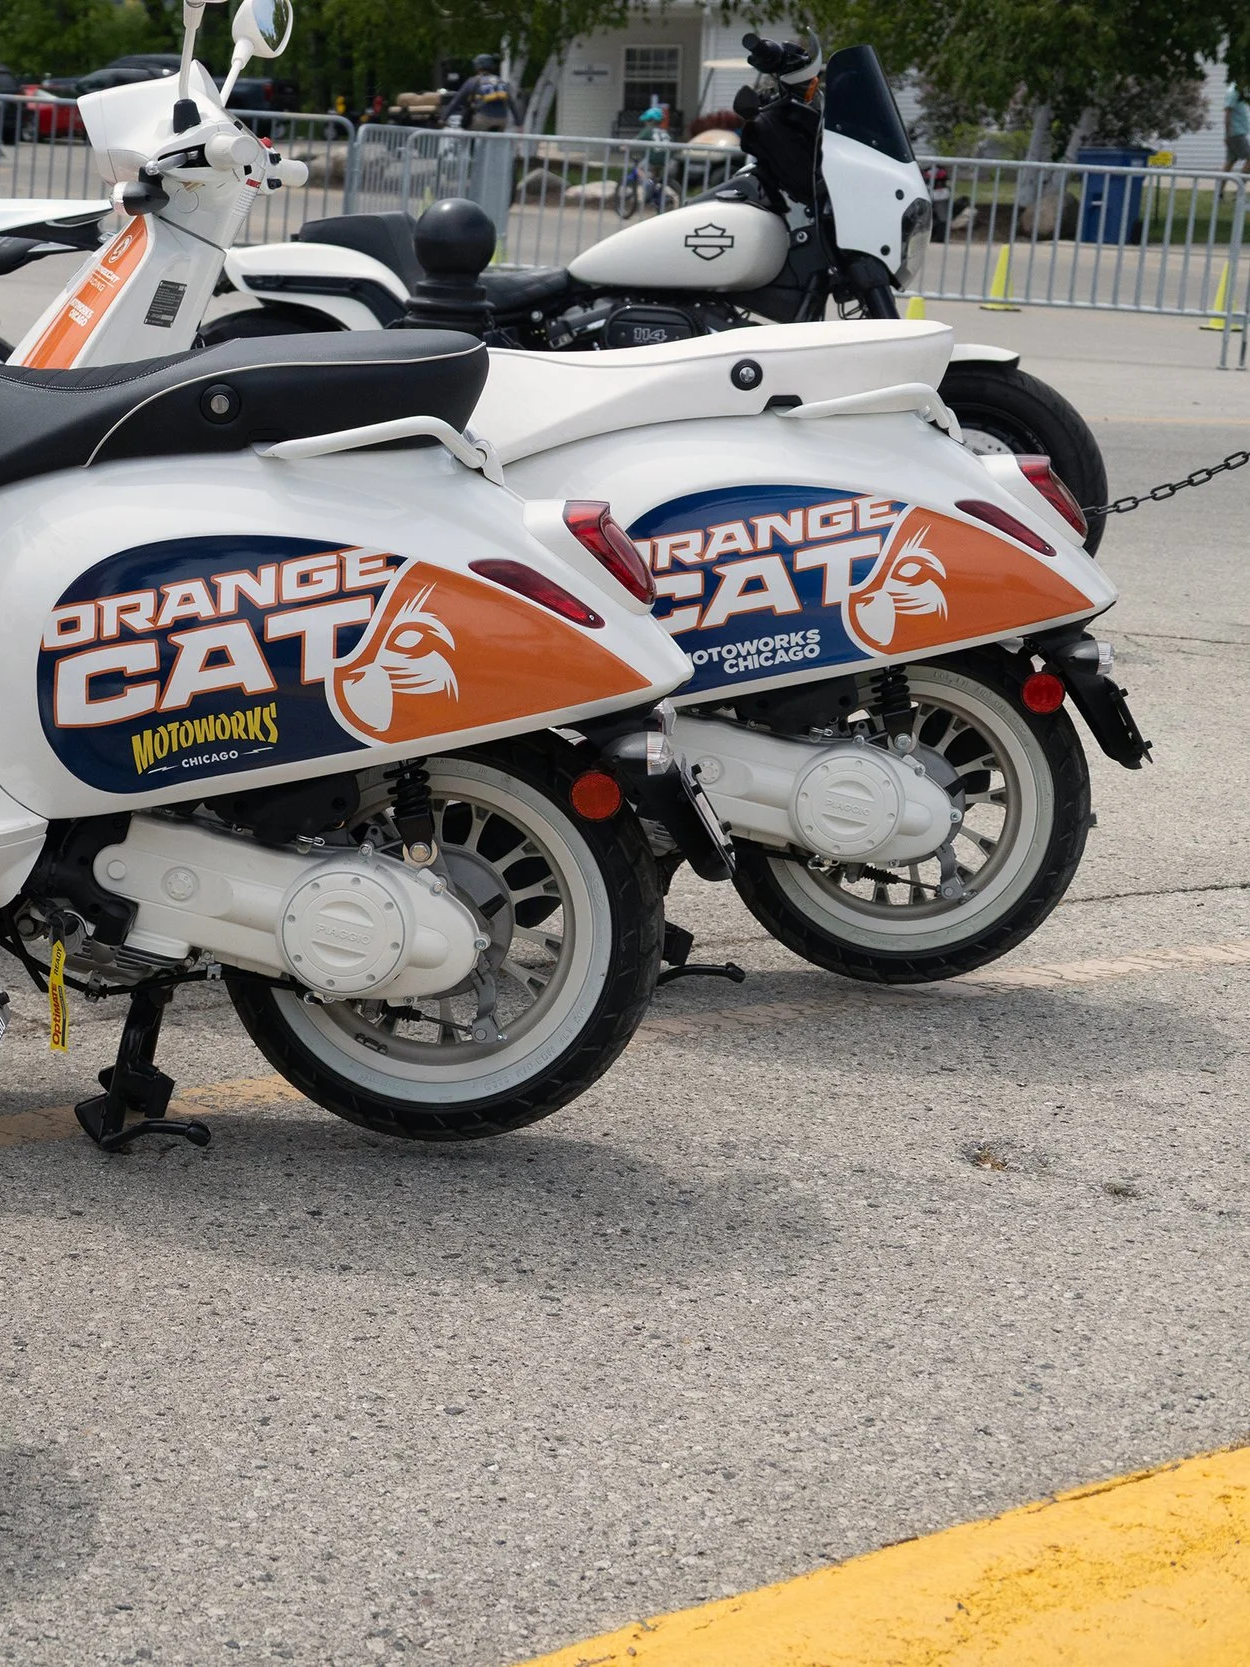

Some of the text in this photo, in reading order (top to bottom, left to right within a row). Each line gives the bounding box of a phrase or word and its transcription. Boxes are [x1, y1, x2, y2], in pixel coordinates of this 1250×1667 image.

[634, 327, 668, 342] 114
[41, 546, 397, 650] ORANGE
[54, 595, 374, 728] CAT
[723, 644, 821, 674] CHICAGO
[131, 702, 278, 776] MOTOWORKS
[181, 749, 239, 769] CHICAGO
[53, 946, 63, 976] READY
